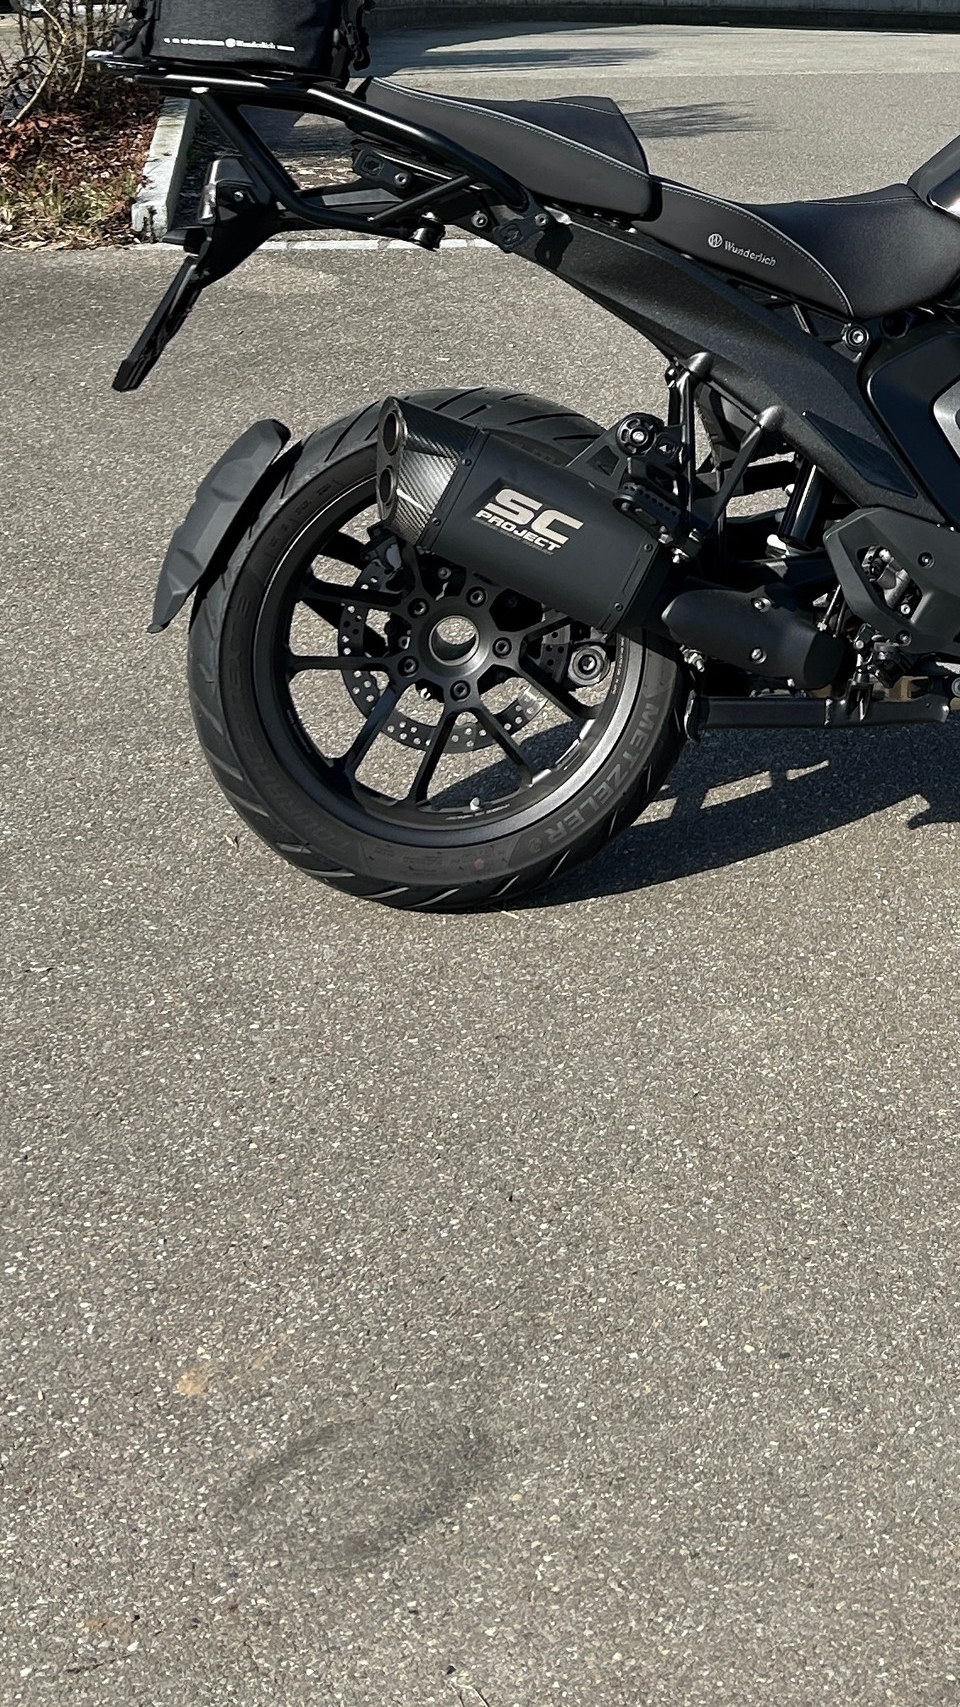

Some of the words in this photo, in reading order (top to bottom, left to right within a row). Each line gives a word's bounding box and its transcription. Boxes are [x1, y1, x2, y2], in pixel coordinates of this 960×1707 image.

[724, 240, 777, 268] Wunderlich
[475, 509, 562, 551] PROJECT
[484, 488, 584, 545] SC
[542, 701, 661, 844] METZELER
